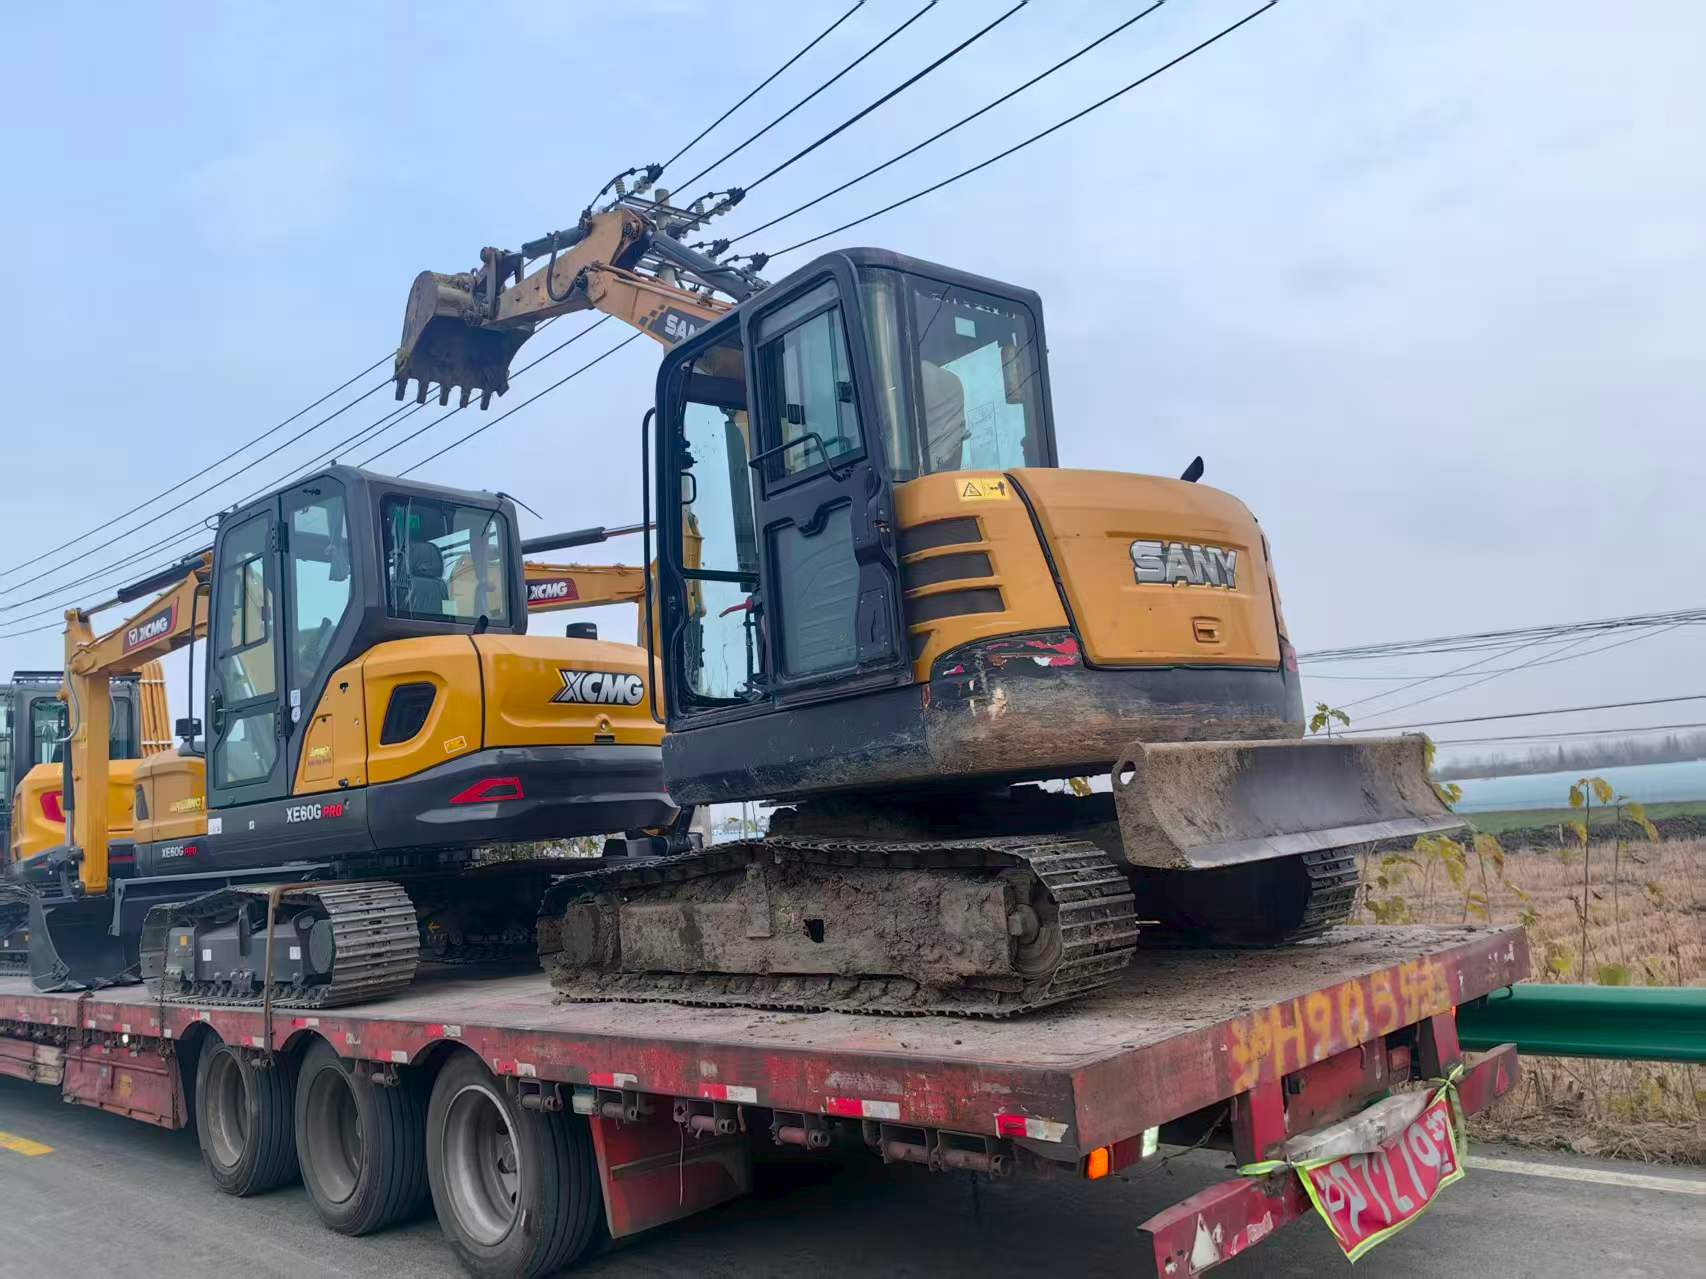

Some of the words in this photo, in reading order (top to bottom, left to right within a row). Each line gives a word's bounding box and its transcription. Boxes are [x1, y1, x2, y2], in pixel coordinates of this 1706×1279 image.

[665, 313, 701, 339] SAN
[1129, 540, 1237, 589] SANY
[530, 581, 568, 600] XCMG
[549, 670, 644, 706] XCMG
[286, 803, 321, 824] XE60G
[322, 803, 344, 818] PRO
